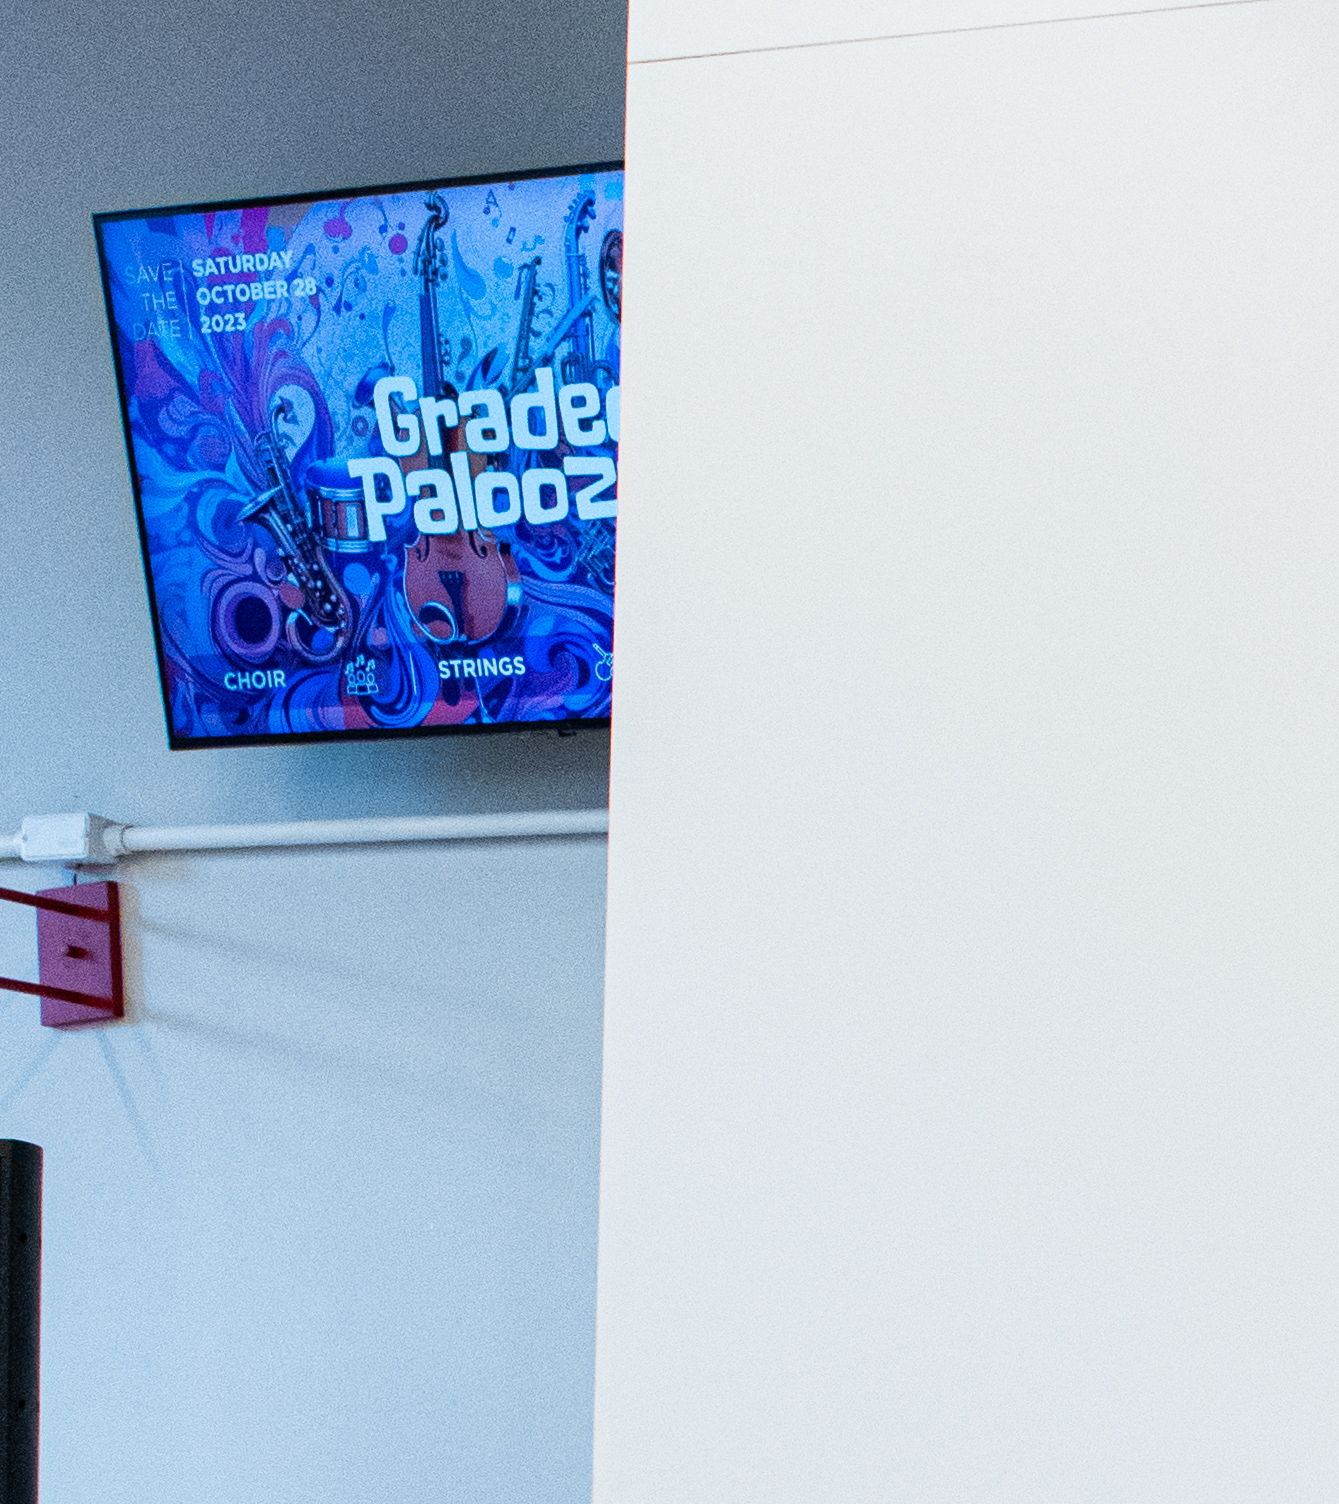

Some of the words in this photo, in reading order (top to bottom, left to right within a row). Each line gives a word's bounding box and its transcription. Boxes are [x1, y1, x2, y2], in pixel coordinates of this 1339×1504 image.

[124, 262, 173, 285] SAVE
[192, 250, 293, 277] SATURDAY
[142, 291, 177, 311] THE
[196, 279, 289, 306] OCTOBER
[289, 277, 317, 297] 28
[133, 319, 180, 341] DATE
[201, 312, 247, 333] 2023
[438, 656, 526, 680] STRINGS
[223, 670, 286, 691] CHOIR
